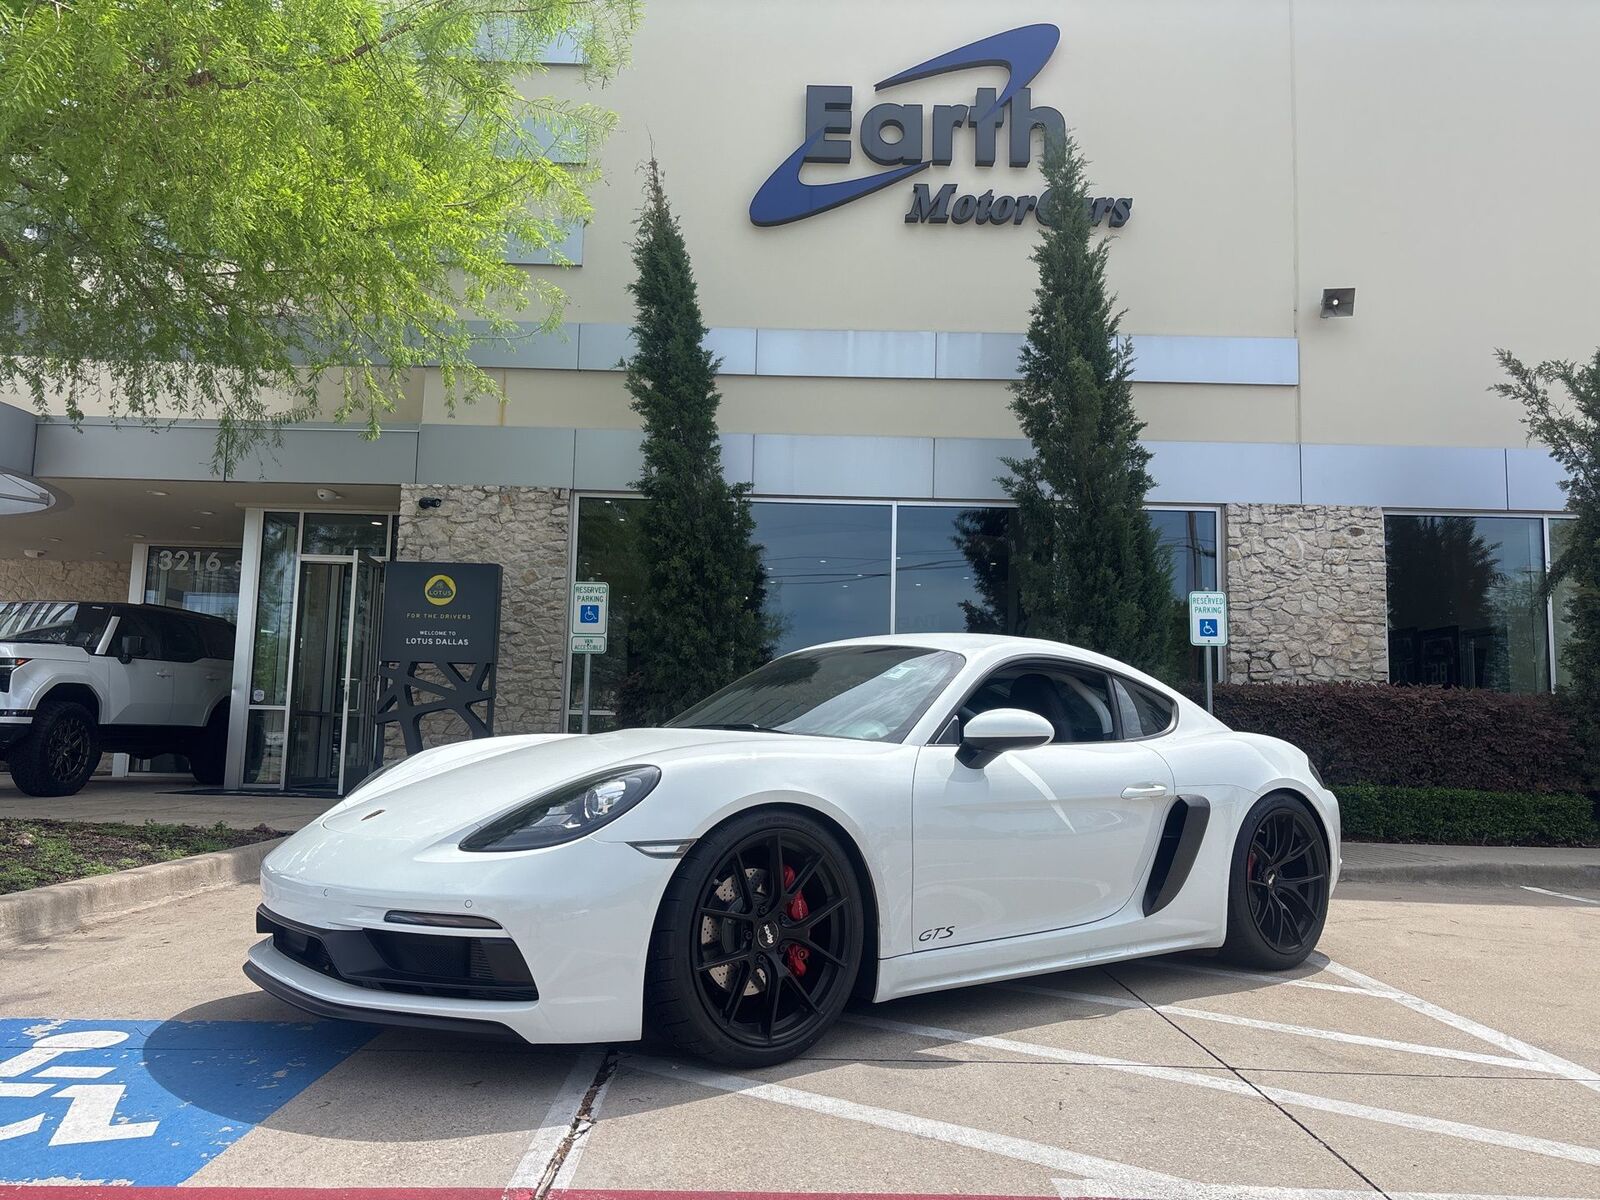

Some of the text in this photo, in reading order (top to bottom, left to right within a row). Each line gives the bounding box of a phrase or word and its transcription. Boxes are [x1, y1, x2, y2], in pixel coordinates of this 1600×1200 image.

[804, 84, 1067, 168] Earth
[904, 183, 1134, 229] MotorCrs
[428, 589, 453, 597] LOTUS
[575, 586, 607, 594] RESERVED
[577, 595, 604, 603] PARKING
[1192, 597, 1224, 605] RESERVED
[1194, 606, 1222, 614] PARKING
[405, 637, 469, 646] LOTUS DALLAS
[918, 925, 956, 942] GTS
